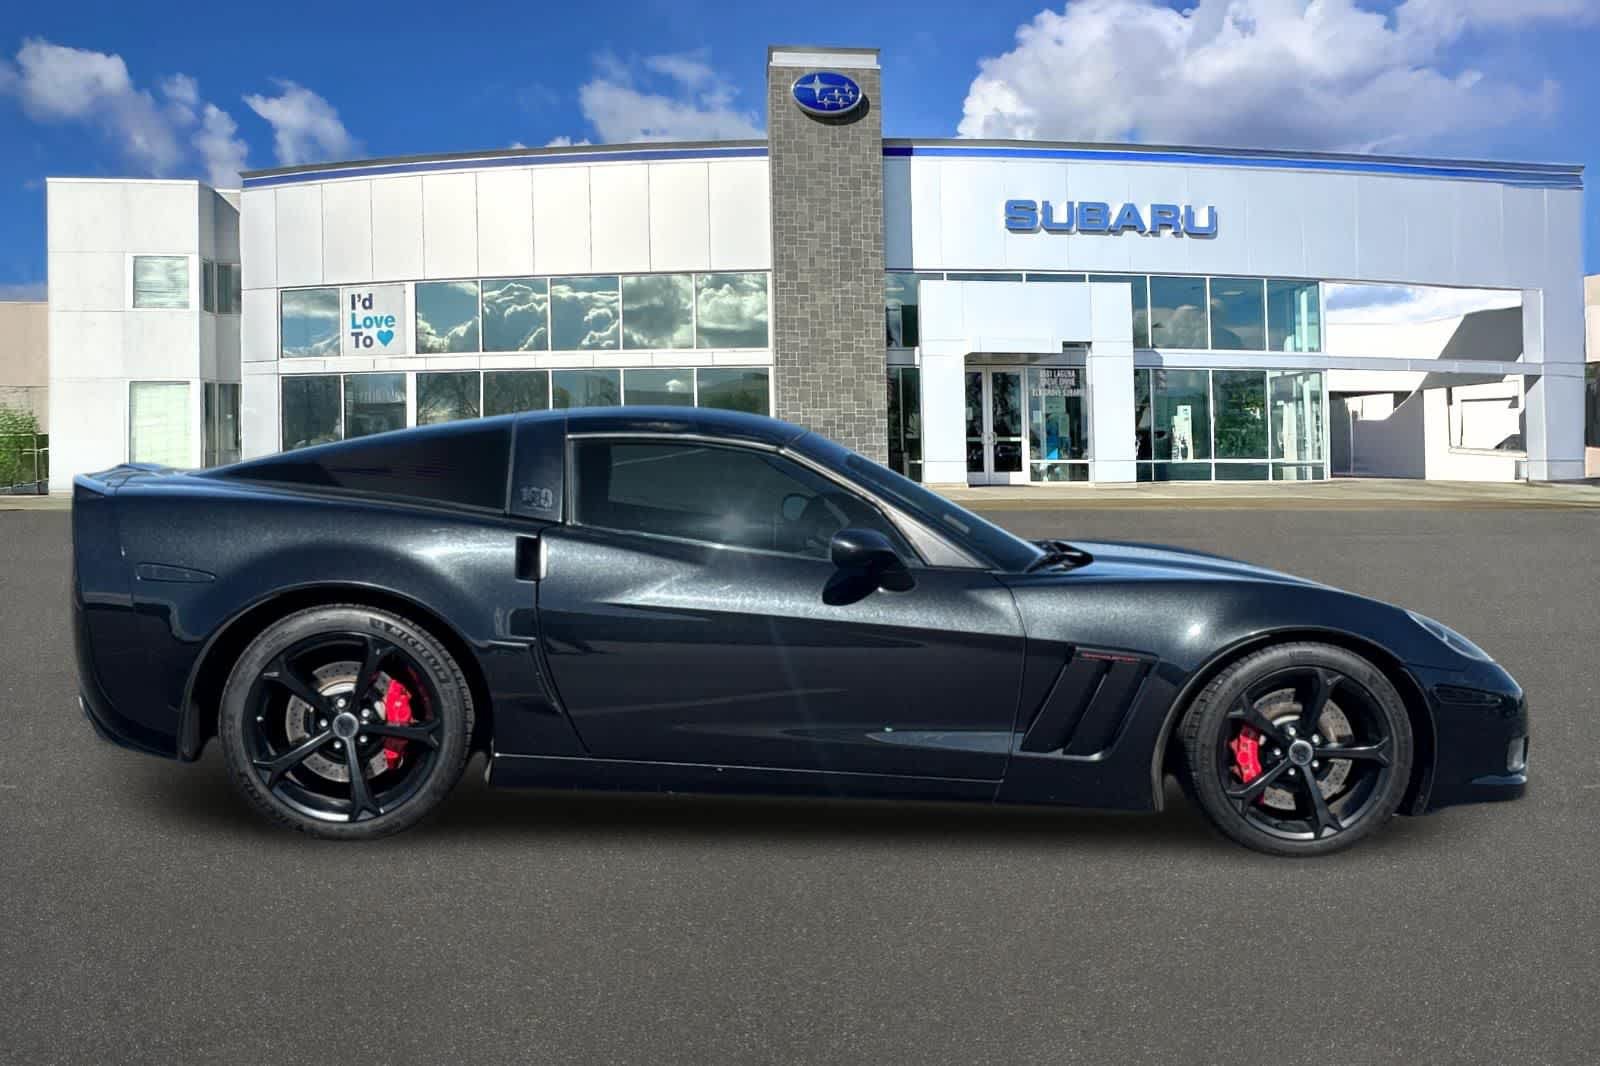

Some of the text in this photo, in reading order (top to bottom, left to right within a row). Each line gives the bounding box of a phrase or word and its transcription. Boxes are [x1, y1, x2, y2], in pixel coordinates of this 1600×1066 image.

[1005, 199, 1217, 236] SUBARU
[351, 293, 373, 310] I'd
[351, 313, 395, 329] Love
[351, 331, 373, 348] To
